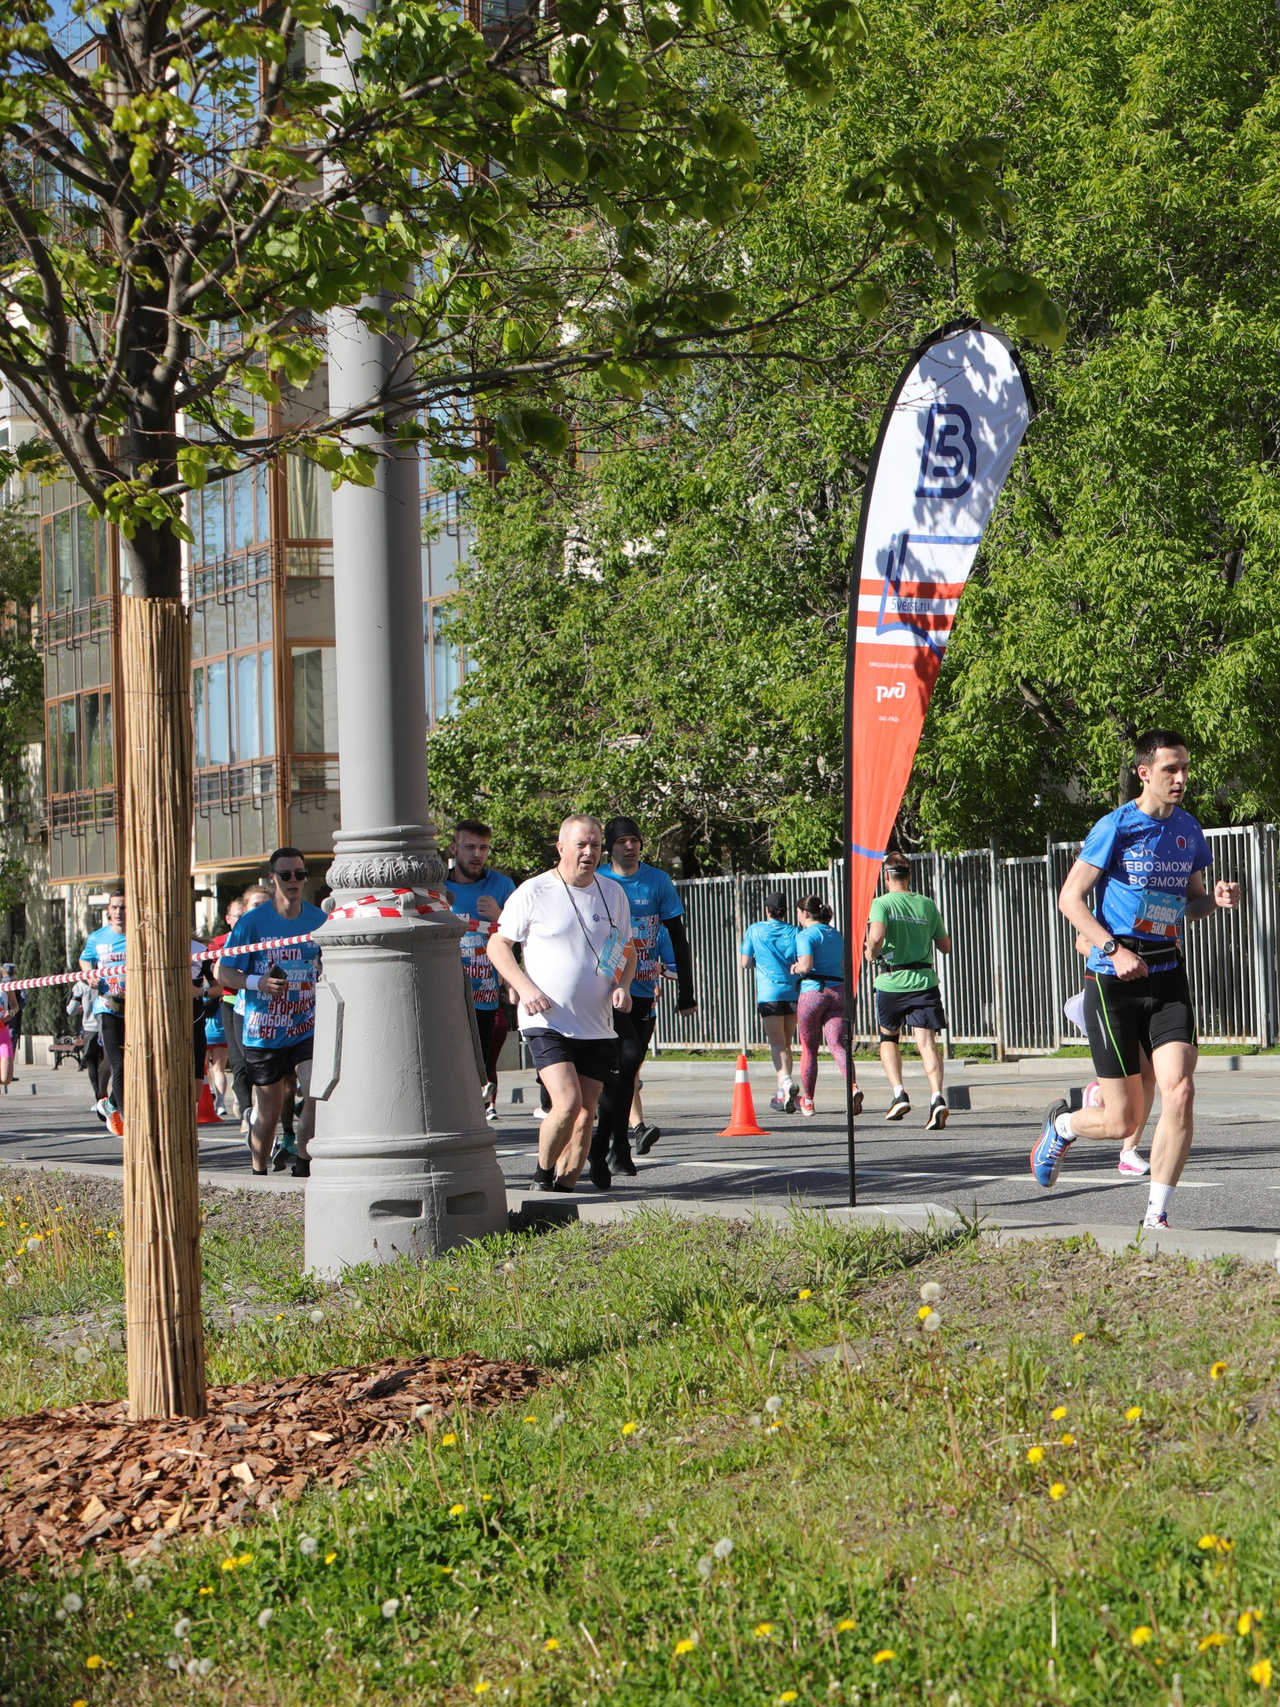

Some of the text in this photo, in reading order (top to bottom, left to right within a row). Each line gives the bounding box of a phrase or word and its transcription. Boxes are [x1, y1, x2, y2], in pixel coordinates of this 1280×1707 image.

[891, 598, 930, 612] 5verst.ru
[1146, 904, 1178, 923] 26963
[1151, 921, 1167, 935] 5KM
[266, 947, 303, 961] #МЕЧТА
